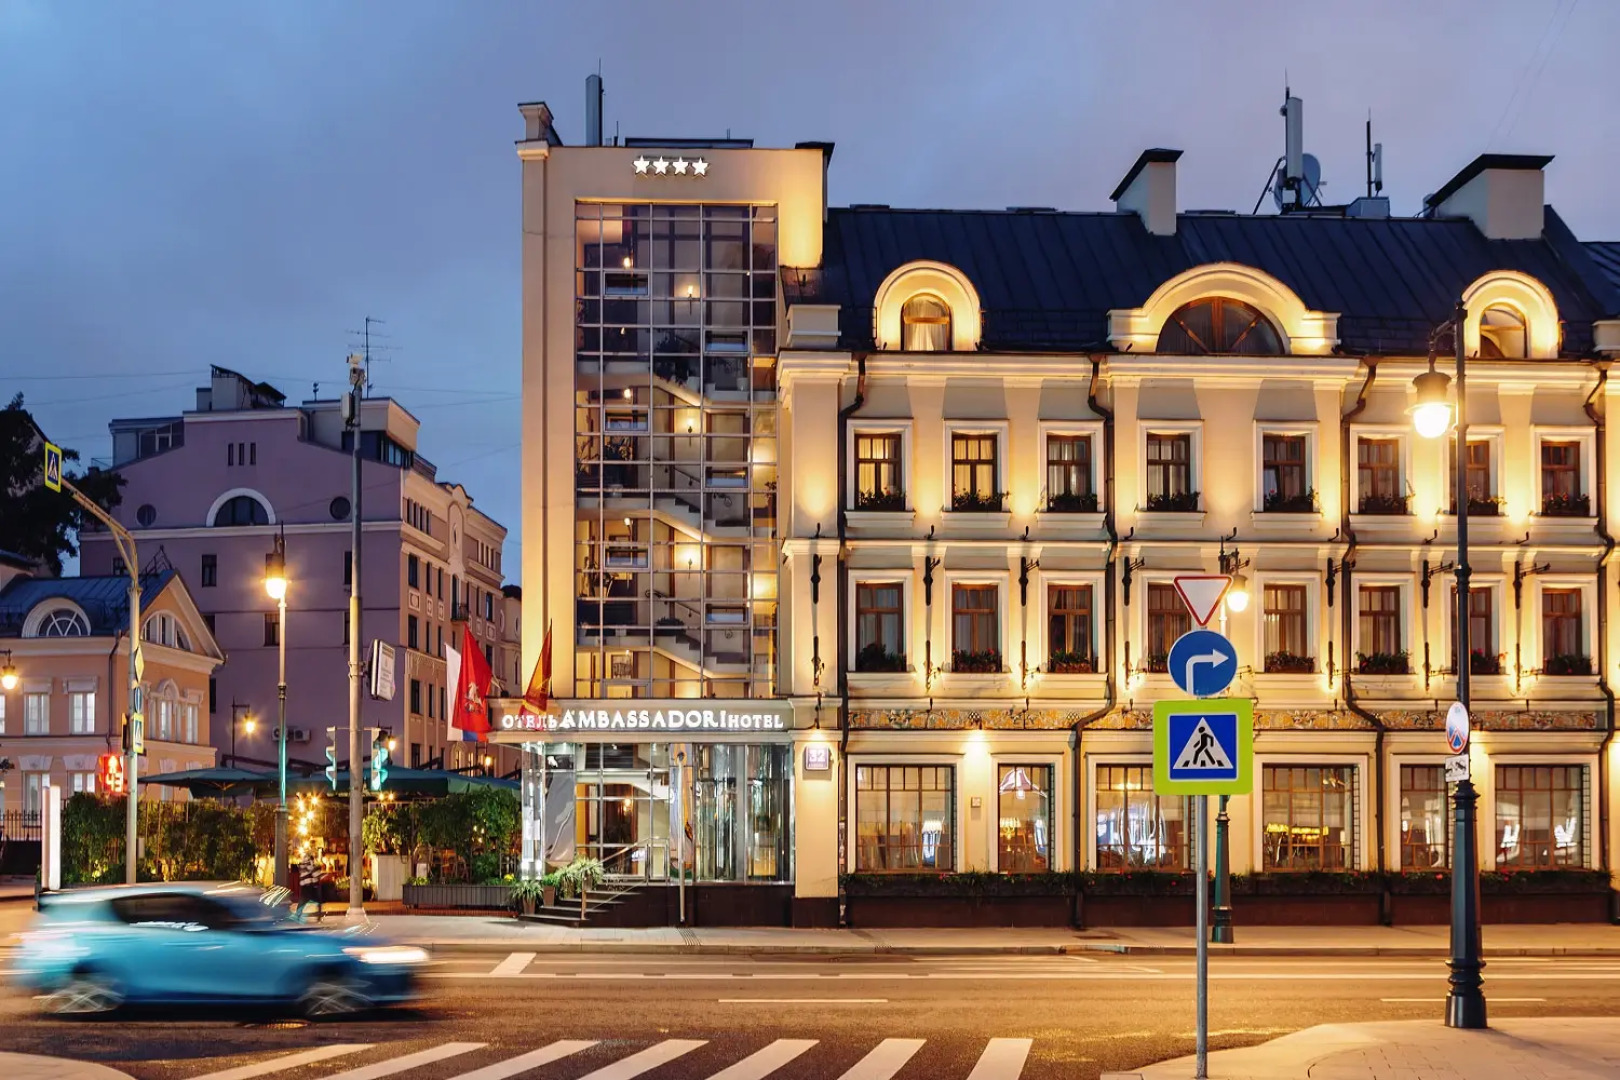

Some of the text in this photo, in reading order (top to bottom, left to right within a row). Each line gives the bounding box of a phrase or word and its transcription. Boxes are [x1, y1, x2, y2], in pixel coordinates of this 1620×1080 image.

[502, 709, 784, 729] ОТЕЛЬ AMBASSADORI HOTEL
